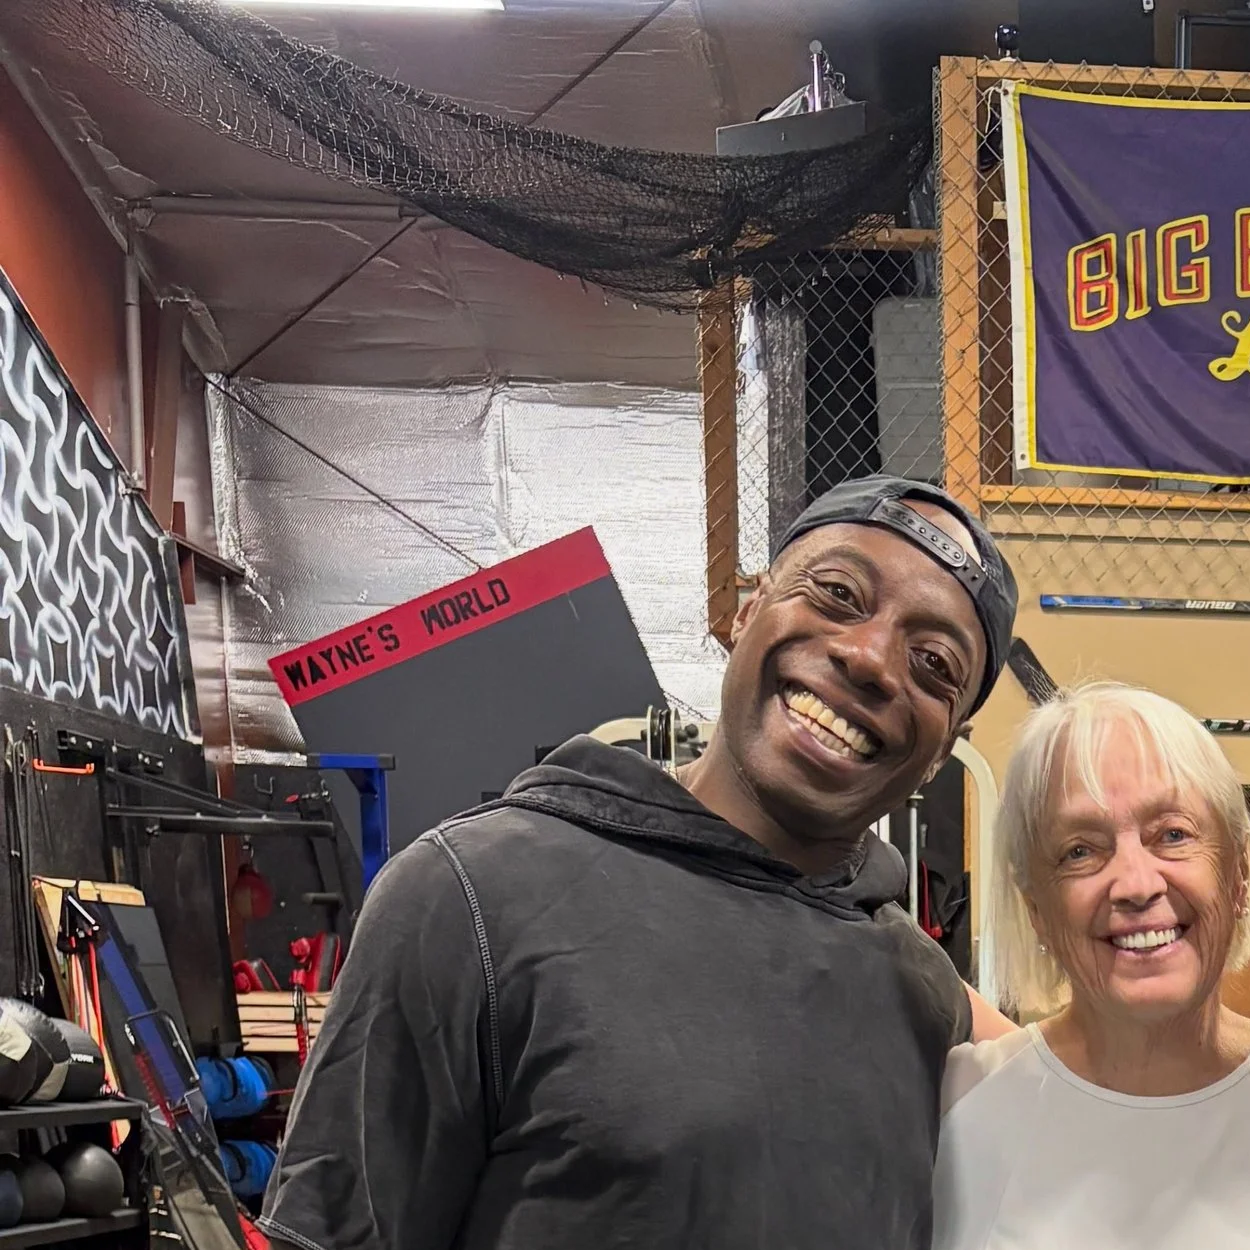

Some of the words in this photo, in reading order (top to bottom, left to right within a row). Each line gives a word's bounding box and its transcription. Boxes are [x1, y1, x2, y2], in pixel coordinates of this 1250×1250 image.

[1067, 214, 1210, 332] BIG
[284, 623, 400, 691] WAYNE'S
[420, 578, 511, 636] WORLD
